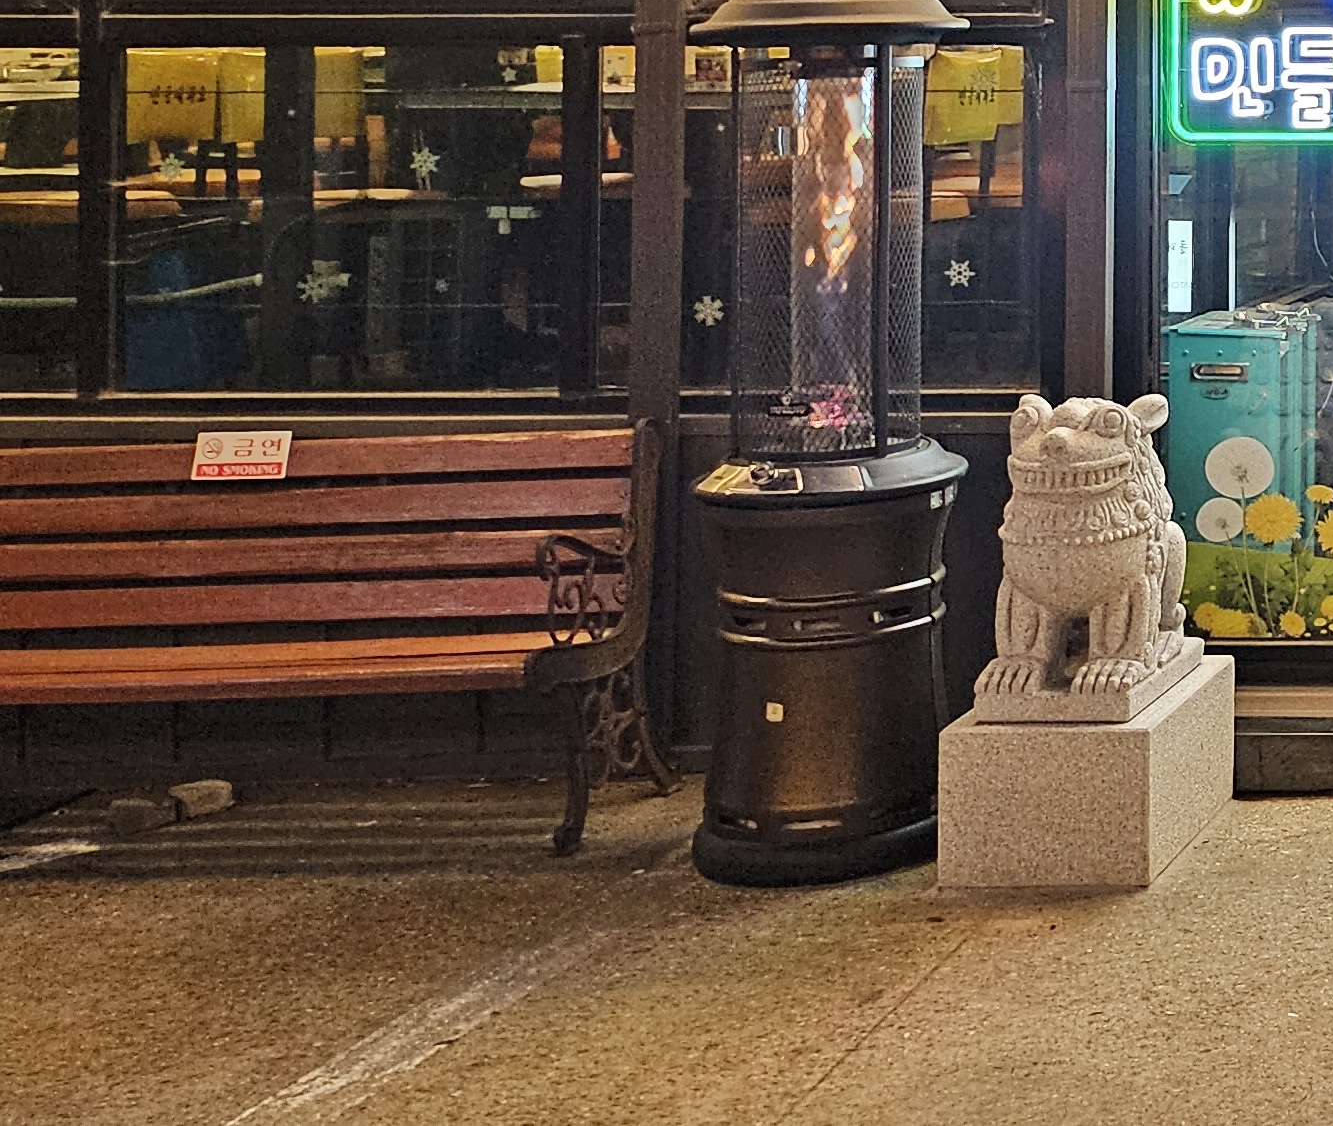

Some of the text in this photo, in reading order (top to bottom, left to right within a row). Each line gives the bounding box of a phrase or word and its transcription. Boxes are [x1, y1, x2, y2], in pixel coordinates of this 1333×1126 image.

[233, 438, 282, 457] 금연
[201, 464, 279, 476] NO SMOKING
